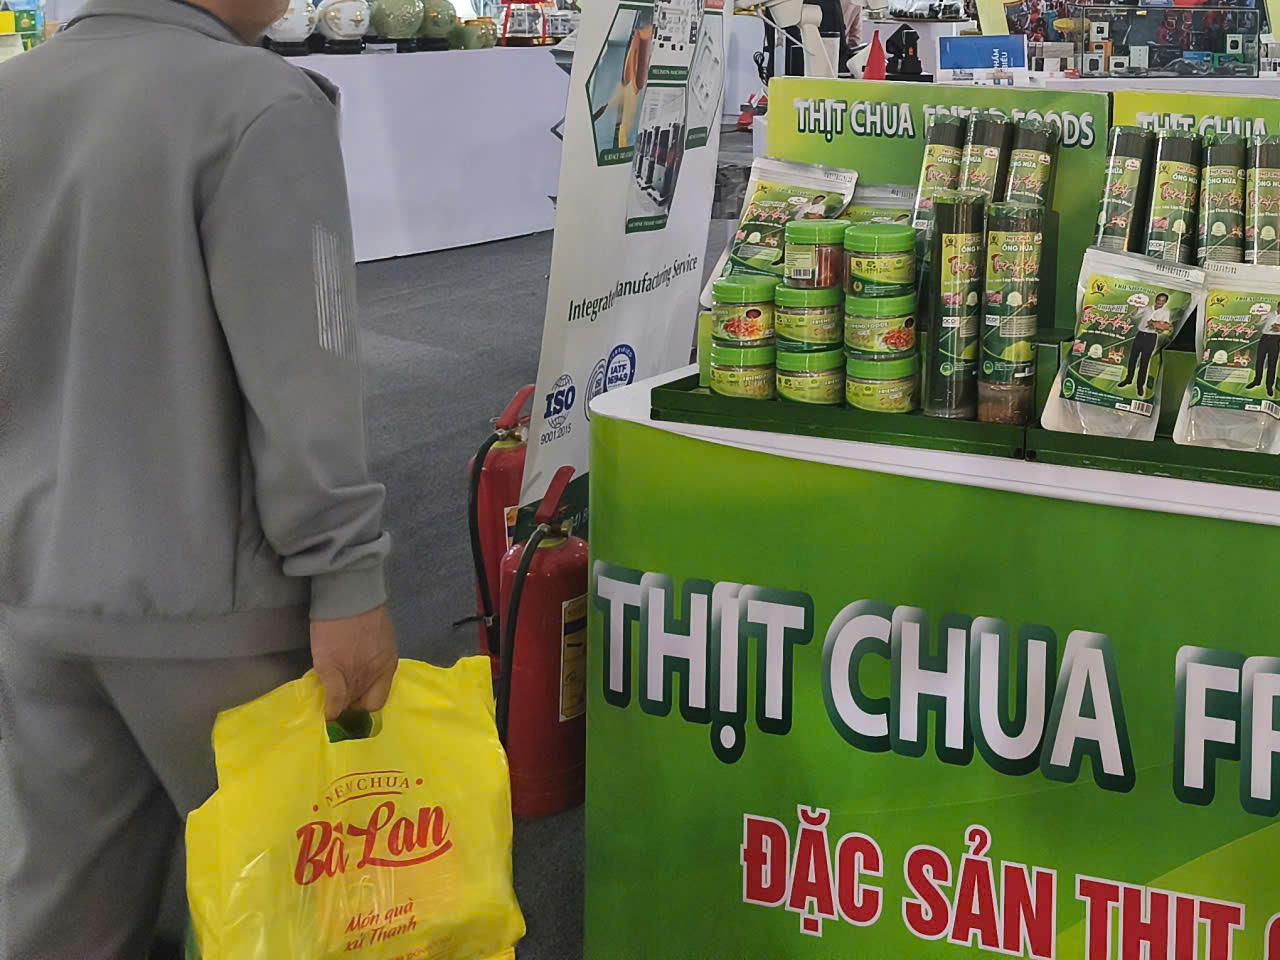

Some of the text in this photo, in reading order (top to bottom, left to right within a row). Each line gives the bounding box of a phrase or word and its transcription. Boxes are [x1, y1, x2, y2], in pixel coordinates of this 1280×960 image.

[796, 99, 847, 143] THỊT
[849, 101, 915, 139] CHUA
[1001, 243, 1019, 252] ỐNG
[672, 253, 698, 278] Service
[607, 373, 629, 386] 16949
[610, 363, 628, 375] IATF
[544, 385, 576, 419] ISO
[594, 561, 813, 763] THỊT
[822, 599, 1136, 793] CHUA
[356, 776, 410, 791] CHUA
[347, 801, 453, 869] Lan
[740, 804, 883, 937] ĐẶC
[902, 824, 1058, 959] SẢN
[344, 897, 414, 934] Món quà
[369, 915, 417, 945] Thanh
